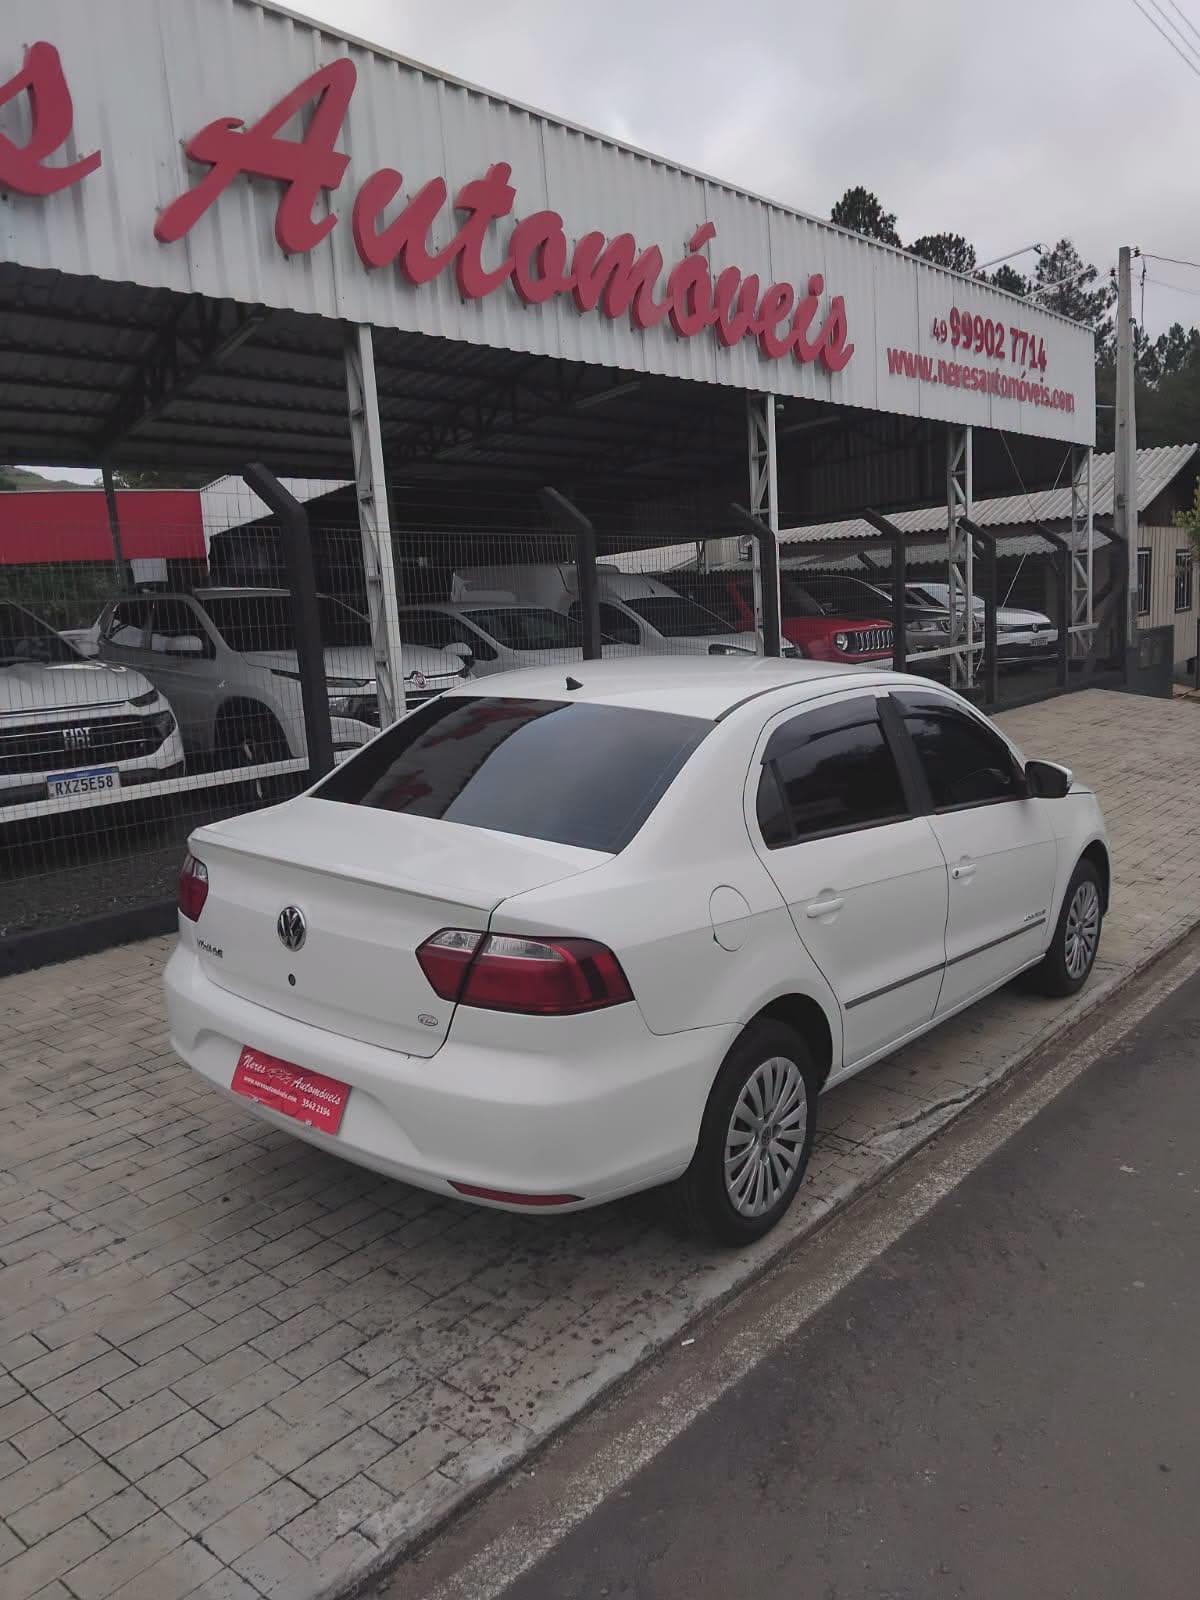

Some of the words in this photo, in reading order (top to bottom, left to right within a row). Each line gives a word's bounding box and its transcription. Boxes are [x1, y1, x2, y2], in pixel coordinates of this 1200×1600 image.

[154, 58, 854, 372] Automóveis
[933, 318, 948, 344] 49
[950, 306, 1006, 359] 99902
[1010, 328, 1047, 372] 7714
[62, 727, 90, 751] FIAT
[55, 775, 113, 796] RXZ5E58
[243, 1055, 266, 1074] Neres
[290, 1077, 340, 1105] Automóveis
